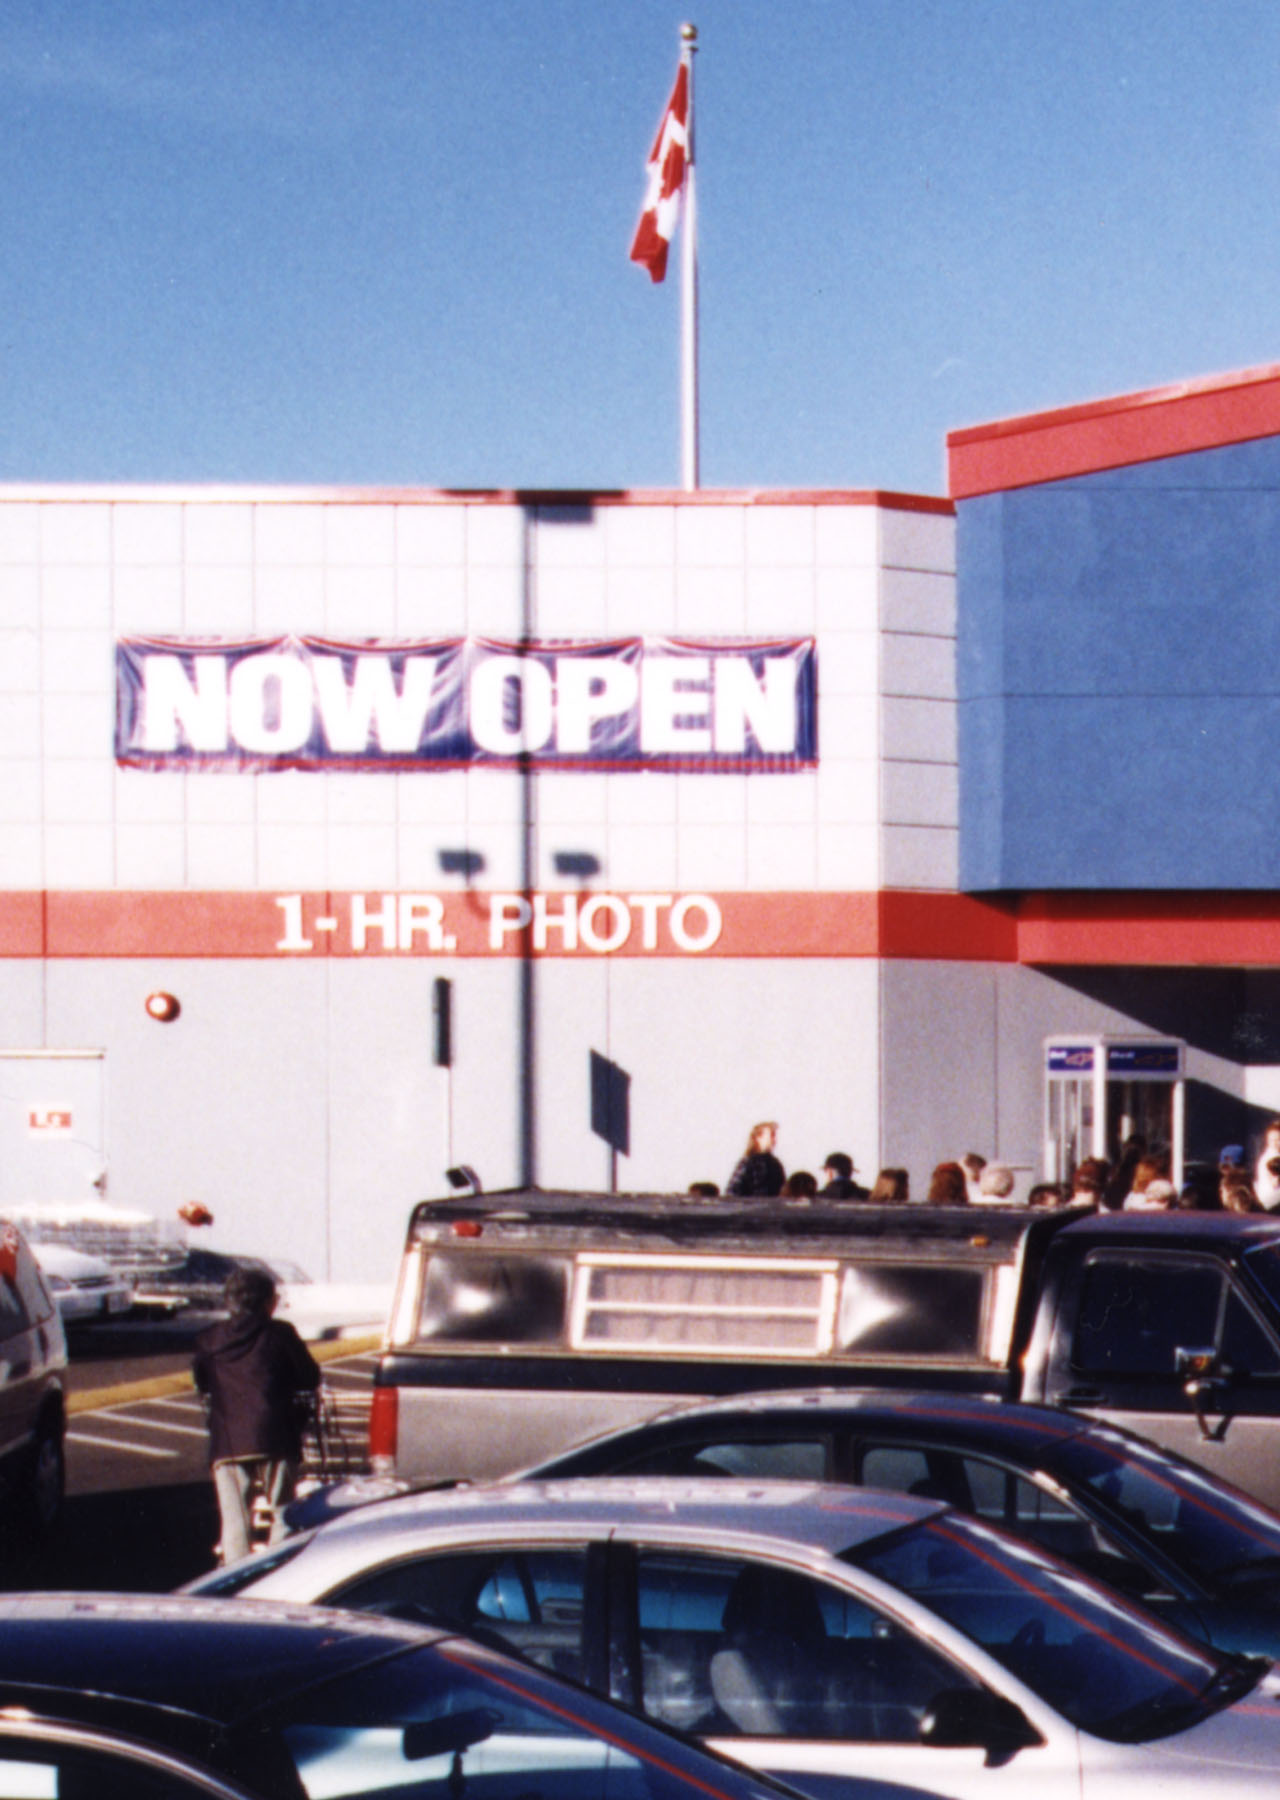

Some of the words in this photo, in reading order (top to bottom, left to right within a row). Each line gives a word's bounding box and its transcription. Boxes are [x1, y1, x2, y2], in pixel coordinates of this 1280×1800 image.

[142, 655, 438, 755] NOW
[468, 655, 796, 755] OPEN
[488, 894, 723, 952] PHOTO
